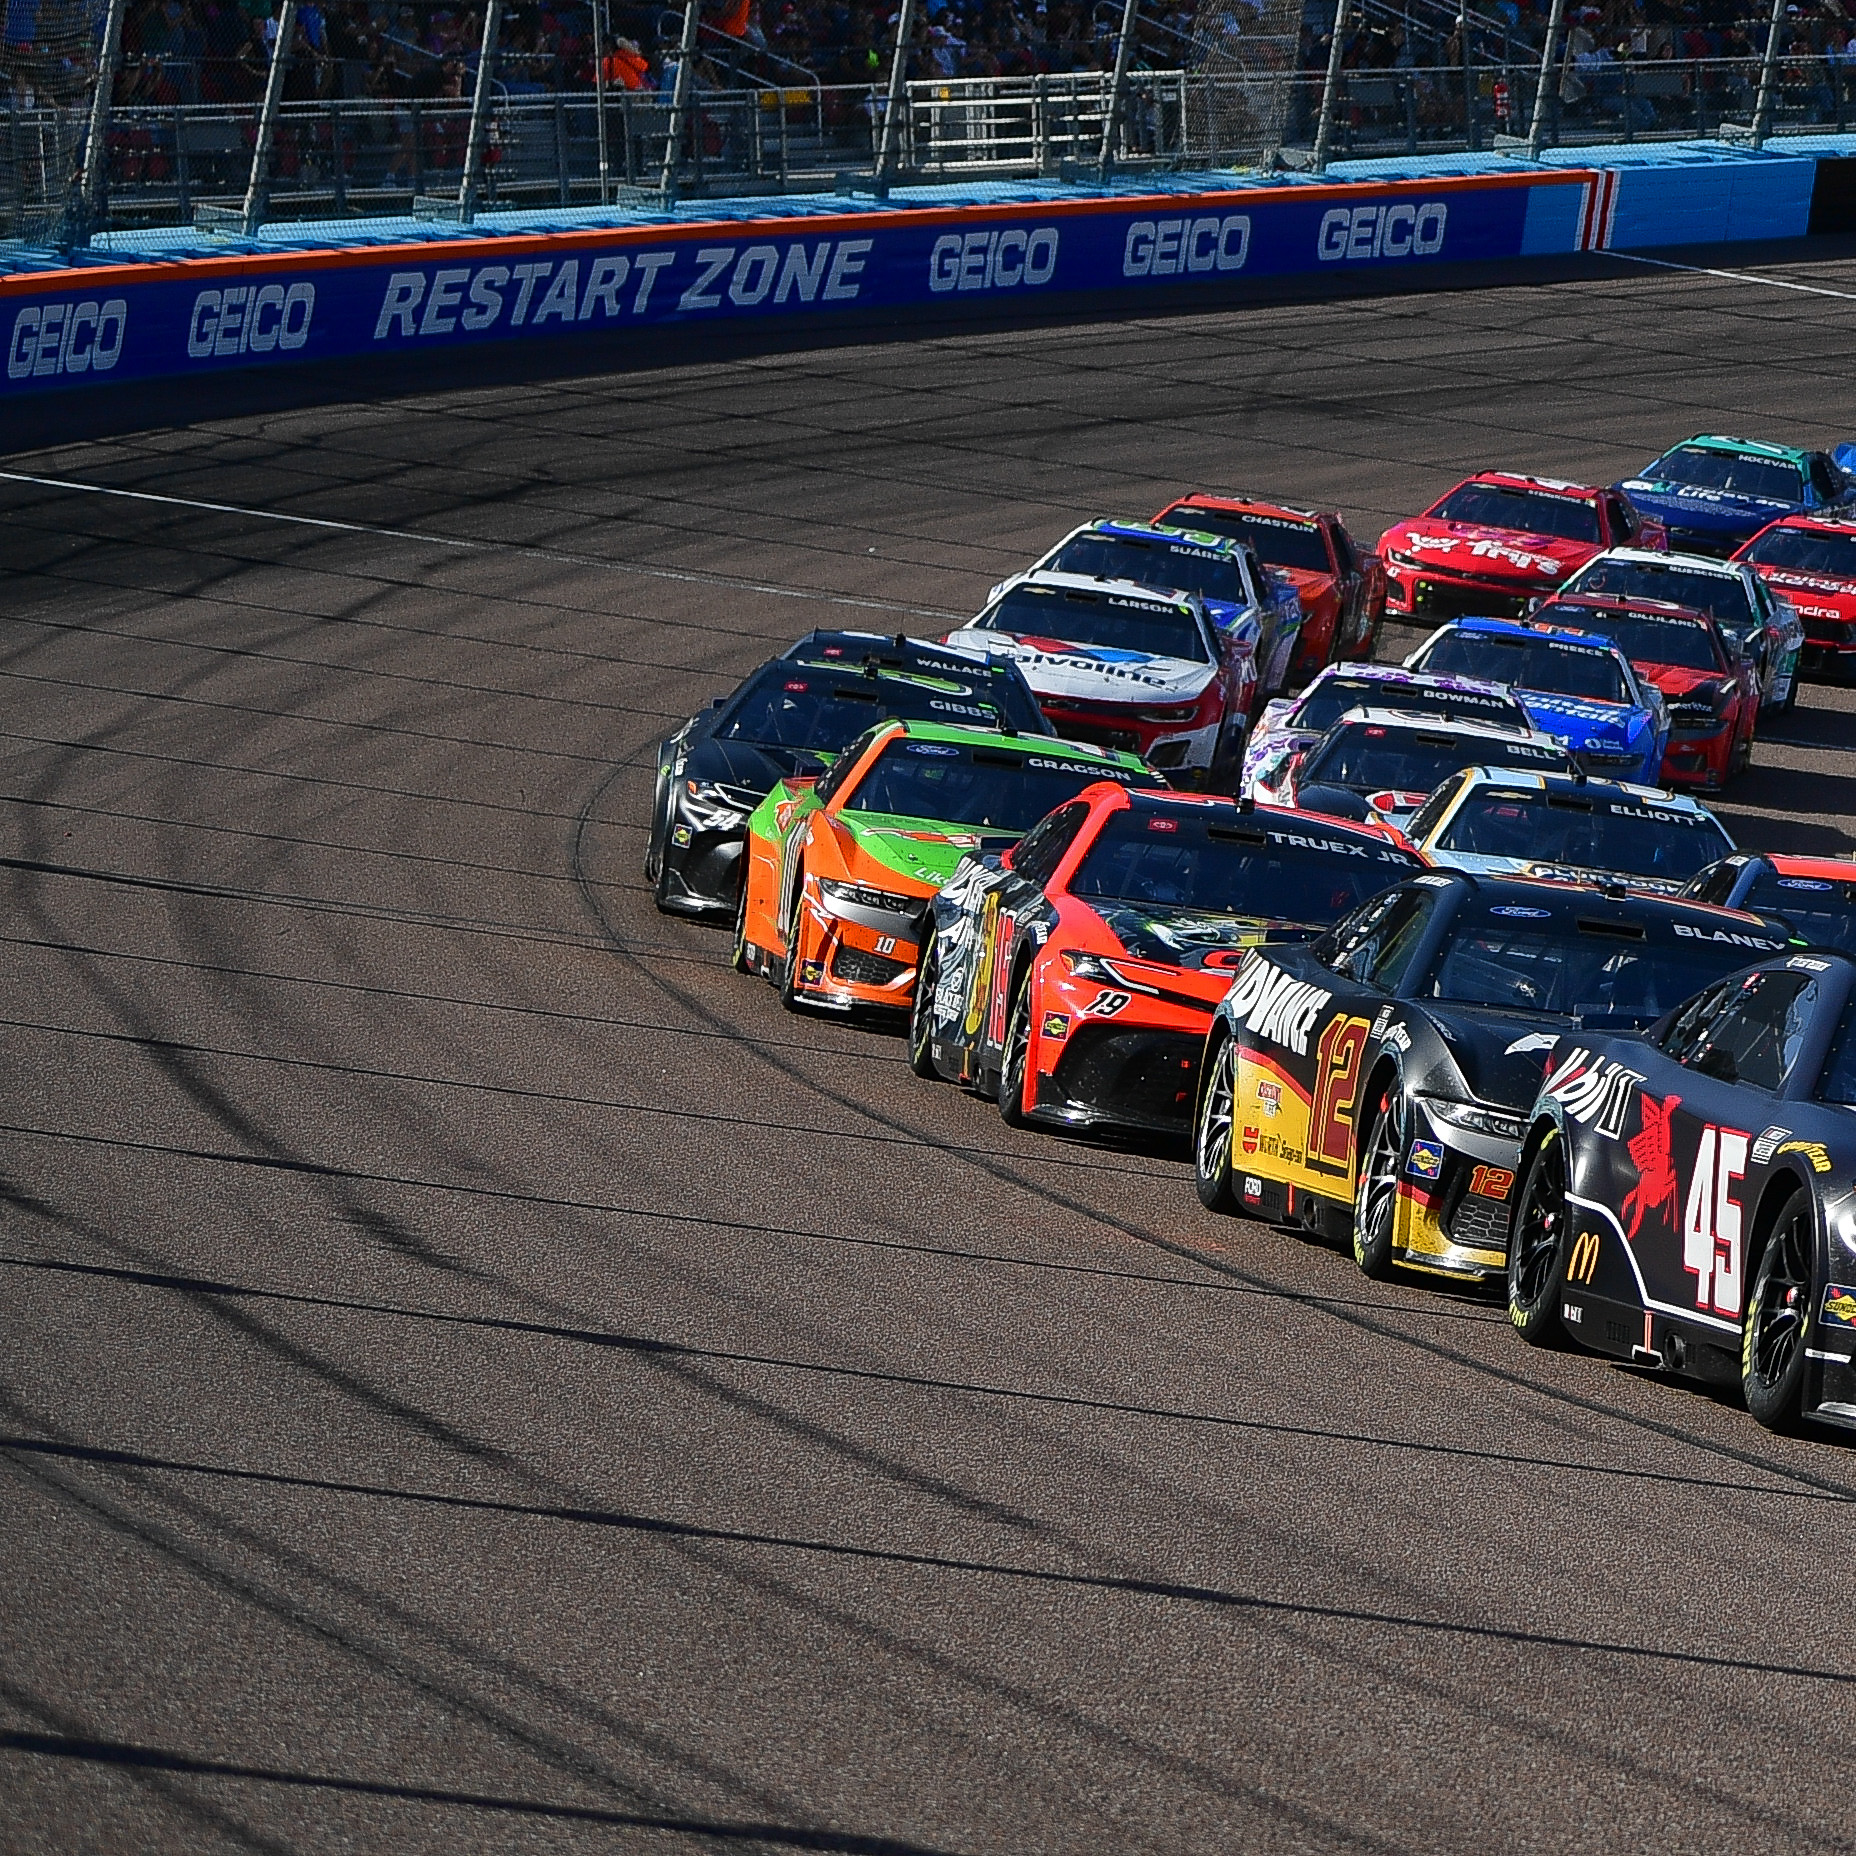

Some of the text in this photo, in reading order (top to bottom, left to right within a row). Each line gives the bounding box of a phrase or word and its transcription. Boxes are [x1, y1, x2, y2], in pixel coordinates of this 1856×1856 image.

[1121, 215, 1251, 278] GEICO
[1316, 203, 1447, 261] GEICO
[929, 227, 1060, 292] GEICO
[374, 239, 875, 341] RESTART ZONE
[187, 281, 316, 359] GEICO
[7, 298, 128, 380] GEICO
[1108, 597, 1174, 615] LARSON
[916, 658, 993, 678] WALLACE
[929, 699, 997, 721] GIBBS
[1423, 689, 1504, 709] BOWMAN
[1028, 757, 1132, 781] GRAGSON
[1506, 744, 1557, 761] BELL
[1609, 804, 1696, 827] ELLIOTT
[1267, 831, 1421, 869] TRUEX JR.
[873, 935, 897, 955] 10
[1084, 989, 1132, 1018] 19
[1307, 1012, 1373, 1170] 12
[1468, 1164, 1516, 1201] 12
[1684, 1123, 1752, 1318] 45
